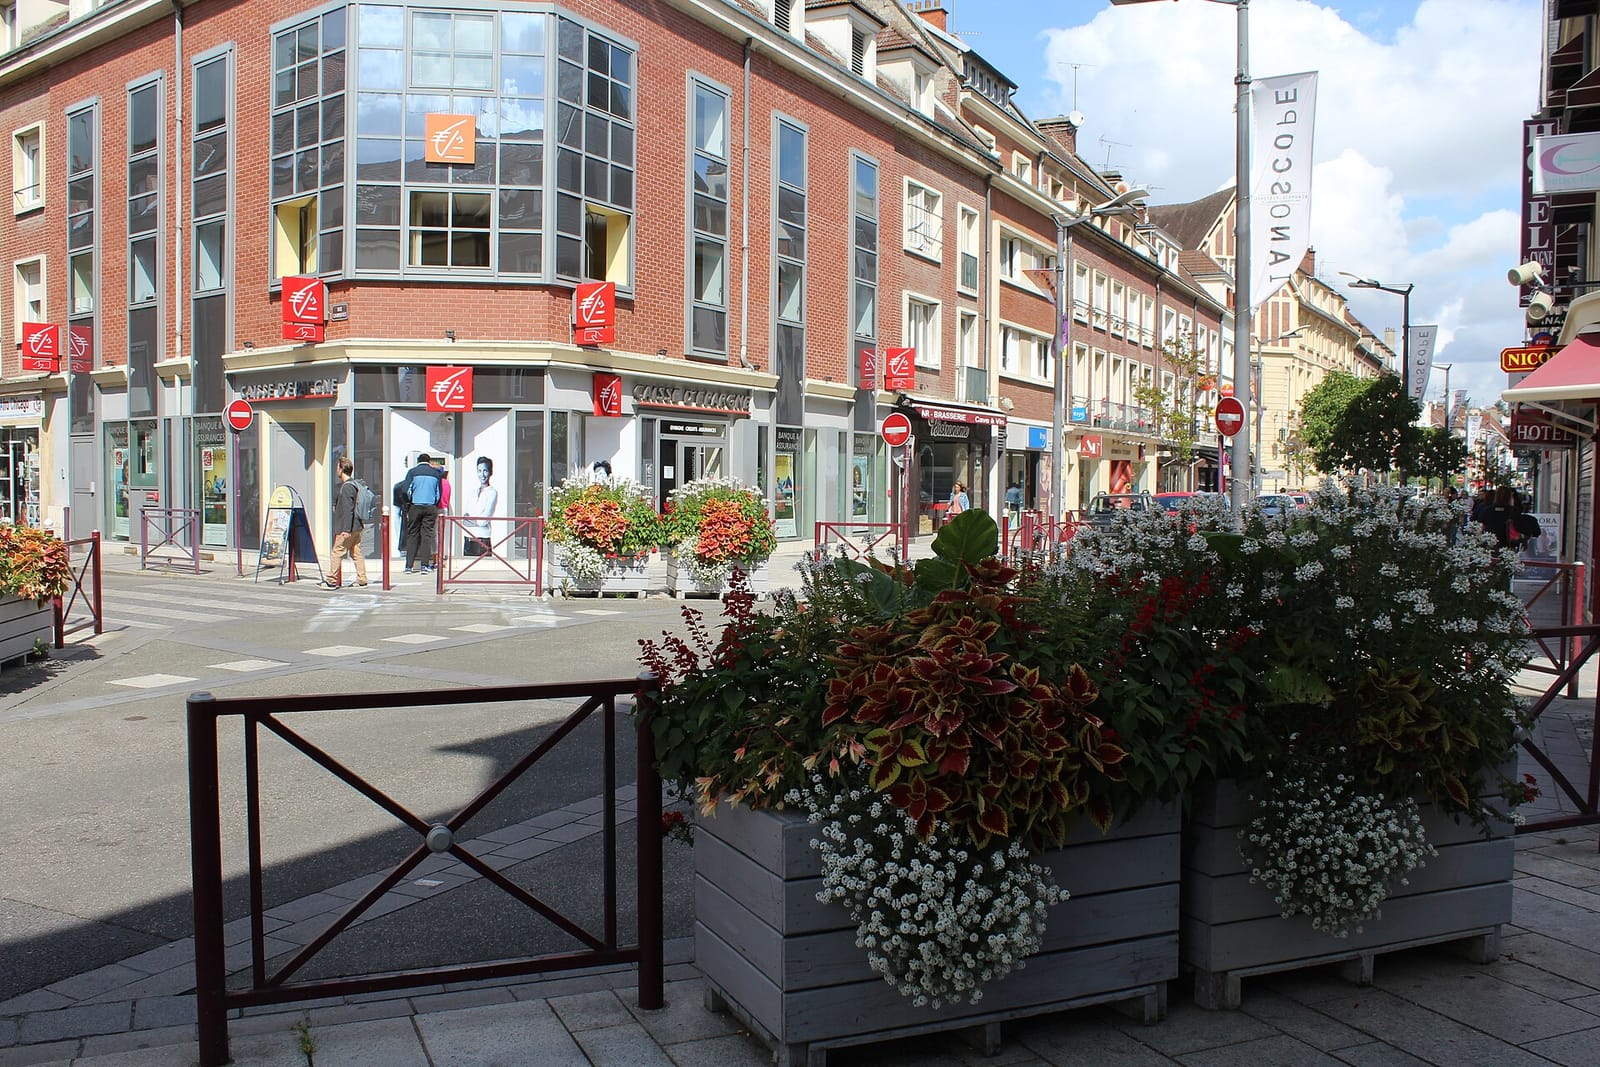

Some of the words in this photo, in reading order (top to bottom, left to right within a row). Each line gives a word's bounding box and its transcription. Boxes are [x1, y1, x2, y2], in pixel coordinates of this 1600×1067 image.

[1526, 123, 1554, 249] HEL
[1508, 352, 1556, 366] NICO
[632, 385, 680, 402] CAISSE
[934, 410, 967, 421] BRASSERIE
[1517, 424, 1573, 441] HOTEL
